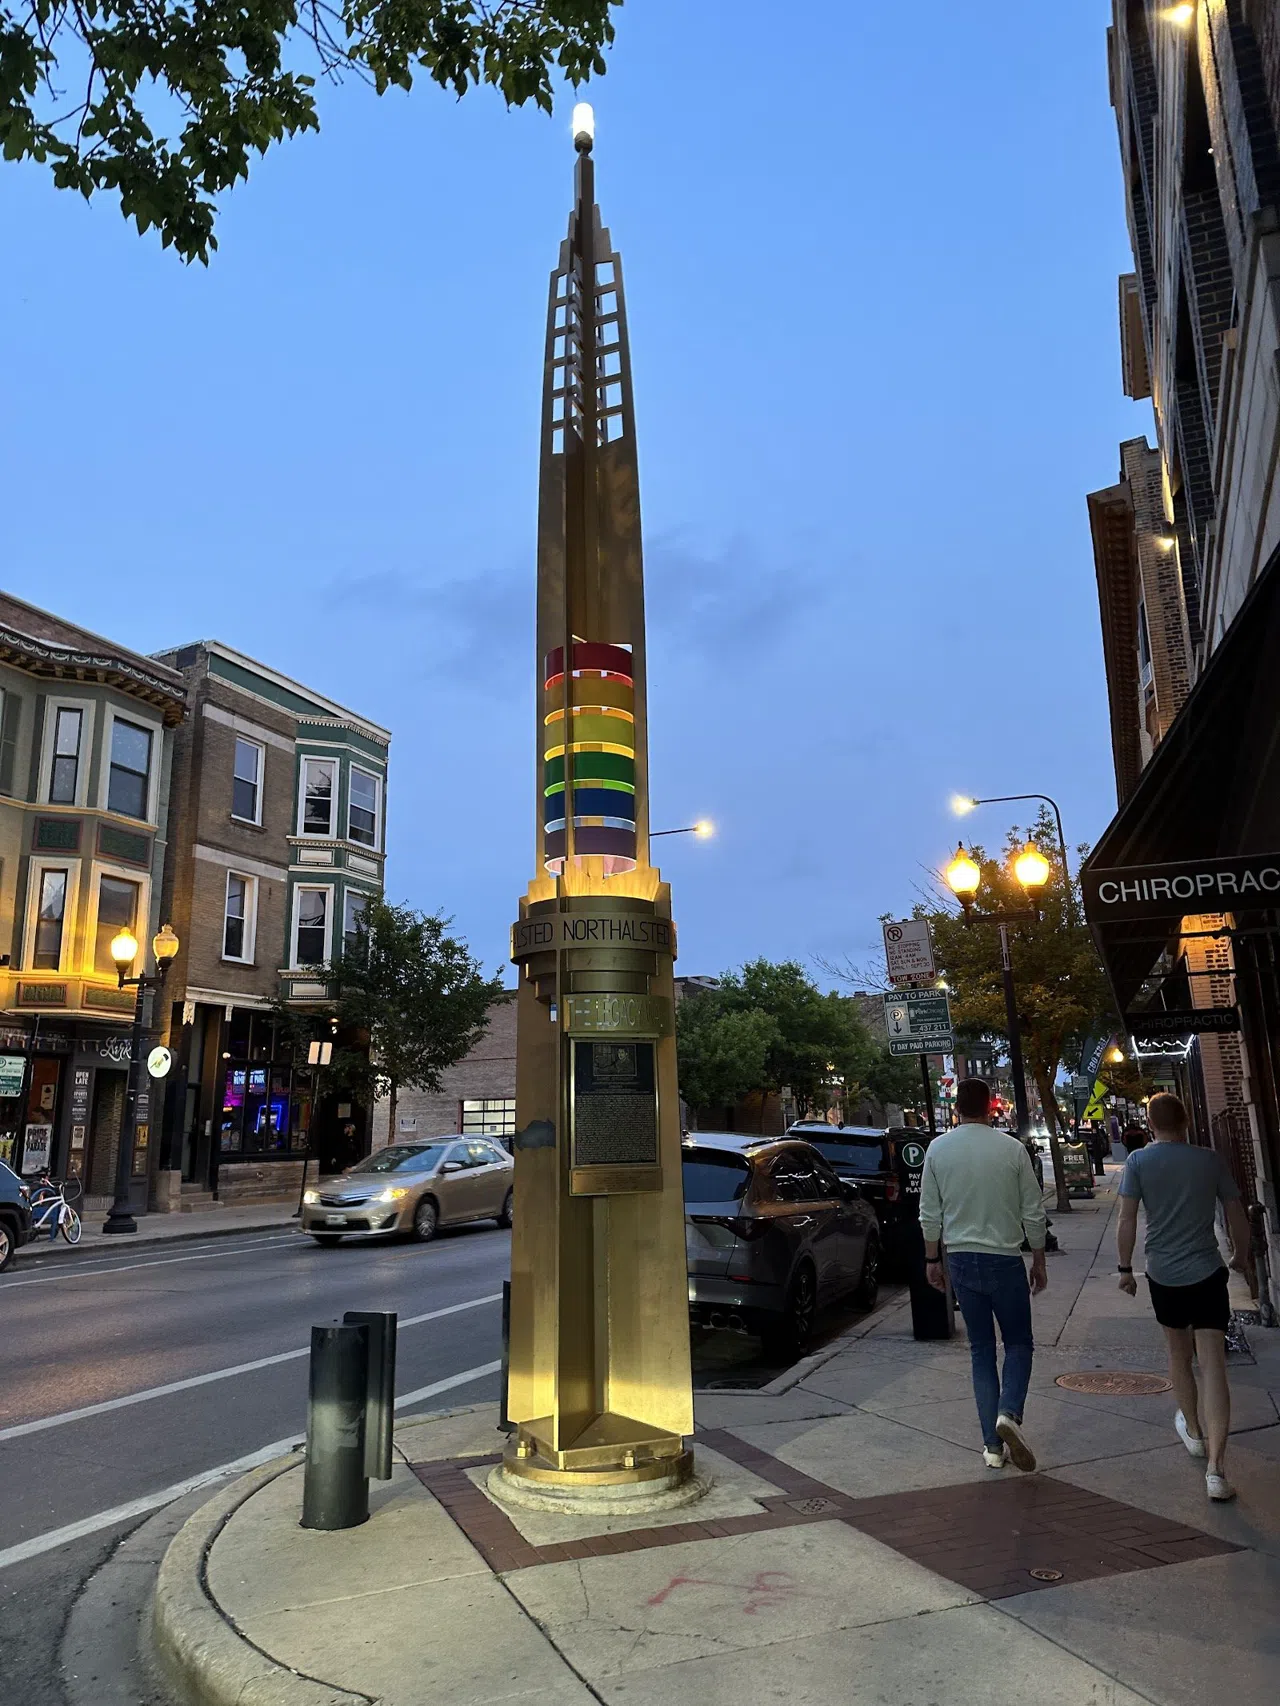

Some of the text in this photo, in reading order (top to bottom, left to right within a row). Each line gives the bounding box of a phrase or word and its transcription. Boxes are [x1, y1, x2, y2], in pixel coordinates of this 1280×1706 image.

[1098, 867, 1280, 904] CHIROPRAC
[563, 919, 670, 946] NORTHALSTED
[897, 942, 920, 950] STOPPING
[897, 947, 922, 955] STANDING
[892, 972, 931, 983] TOW ZONE
[905, 991, 917, 1000] TO
[919, 990, 941, 998] PARK
[1132, 1013, 1235, 1030] CHIROPRACTIC
[919, 1024, 932, 1032] 437
[933, 1023, 947, 1031] 211
[897, 1042, 909, 1050] DAY
[909, 1041, 924, 1050] PAID
[924, 1039, 951, 1049] PARKING
[1087, 1056, 1098, 1074] CBD
[74, 1077, 88, 1085] LATE
[1062, 1154, 1085, 1162] FREE
[908, 1172, 921, 1180] PAY
